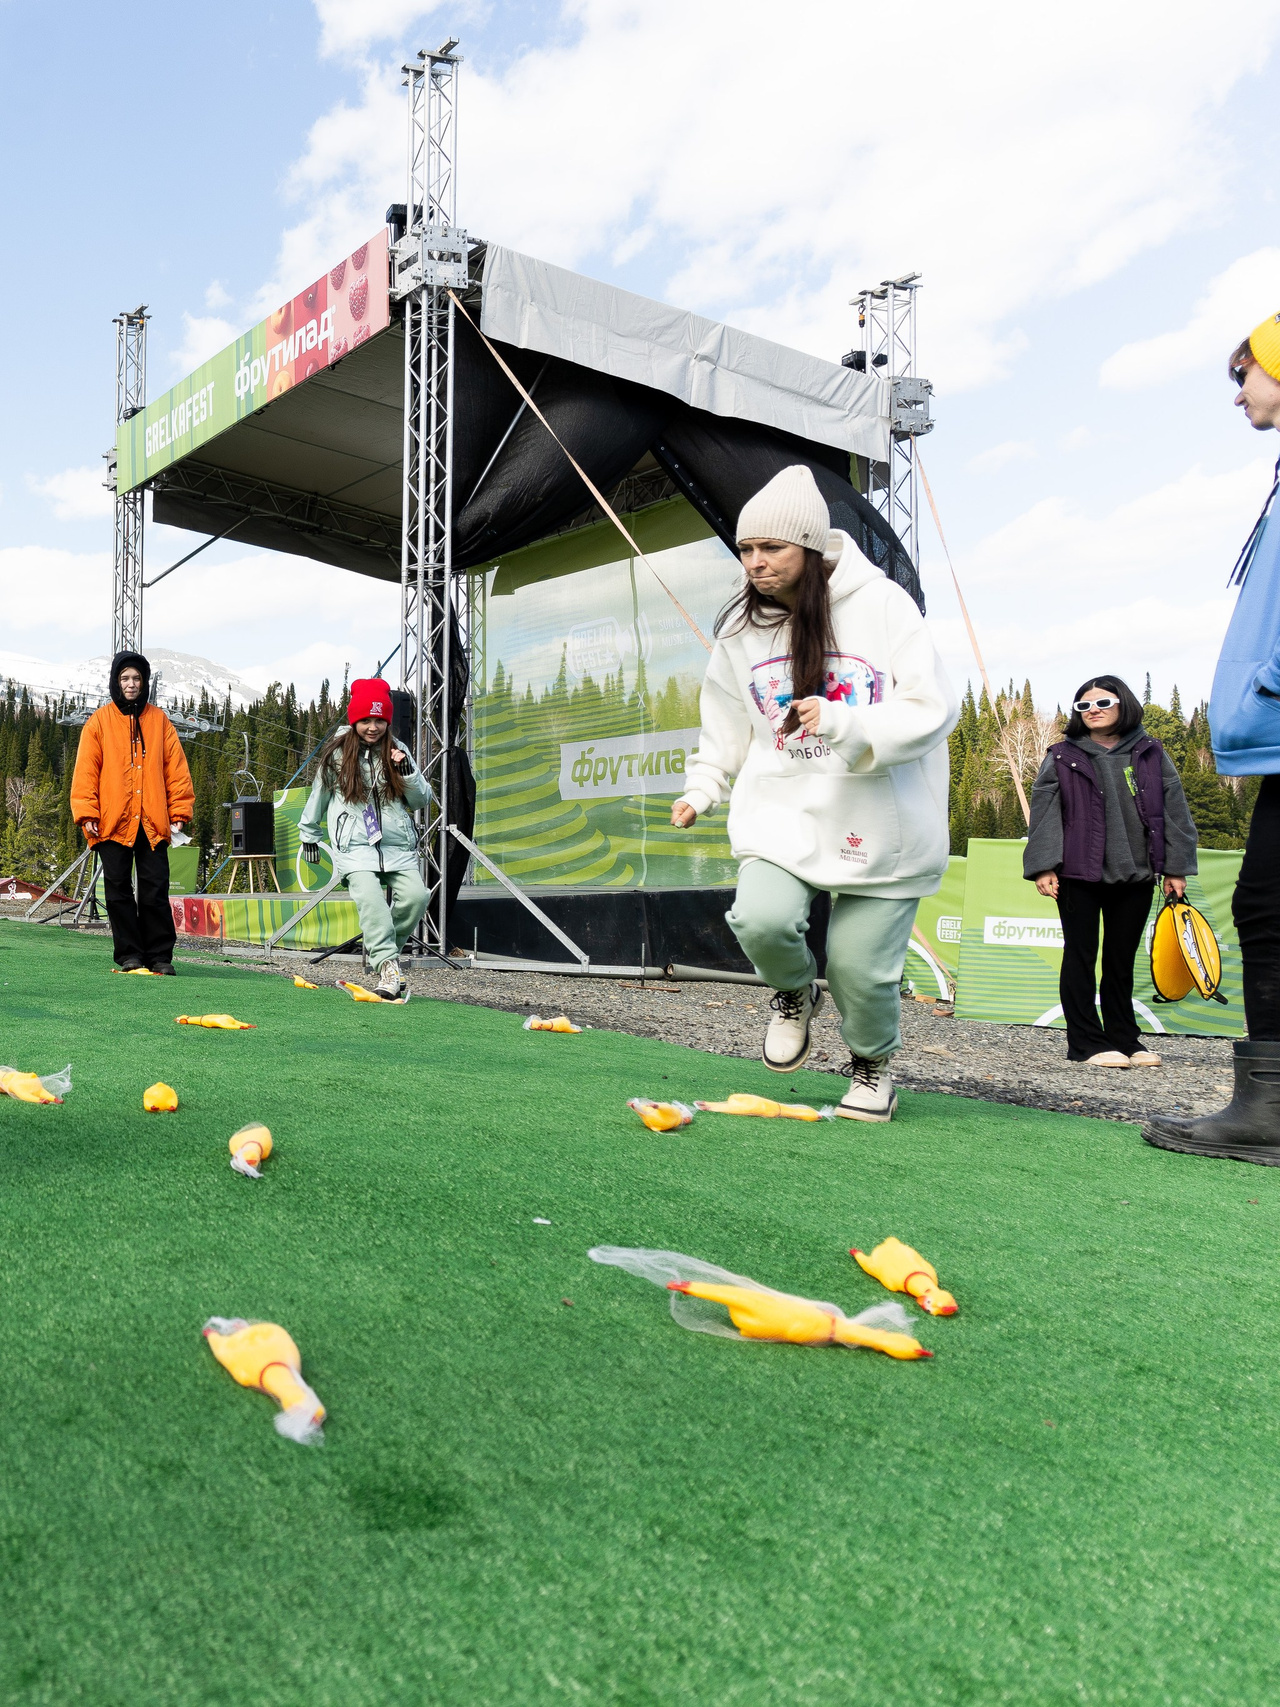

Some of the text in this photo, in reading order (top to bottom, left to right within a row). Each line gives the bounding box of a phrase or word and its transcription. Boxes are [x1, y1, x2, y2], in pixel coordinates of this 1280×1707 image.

[145, 381, 215, 459] GRELKAFEST
[571, 746, 700, 788] фрутила
[941, 919, 962, 930] GRELK
[941, 929, 957, 940] FEST
